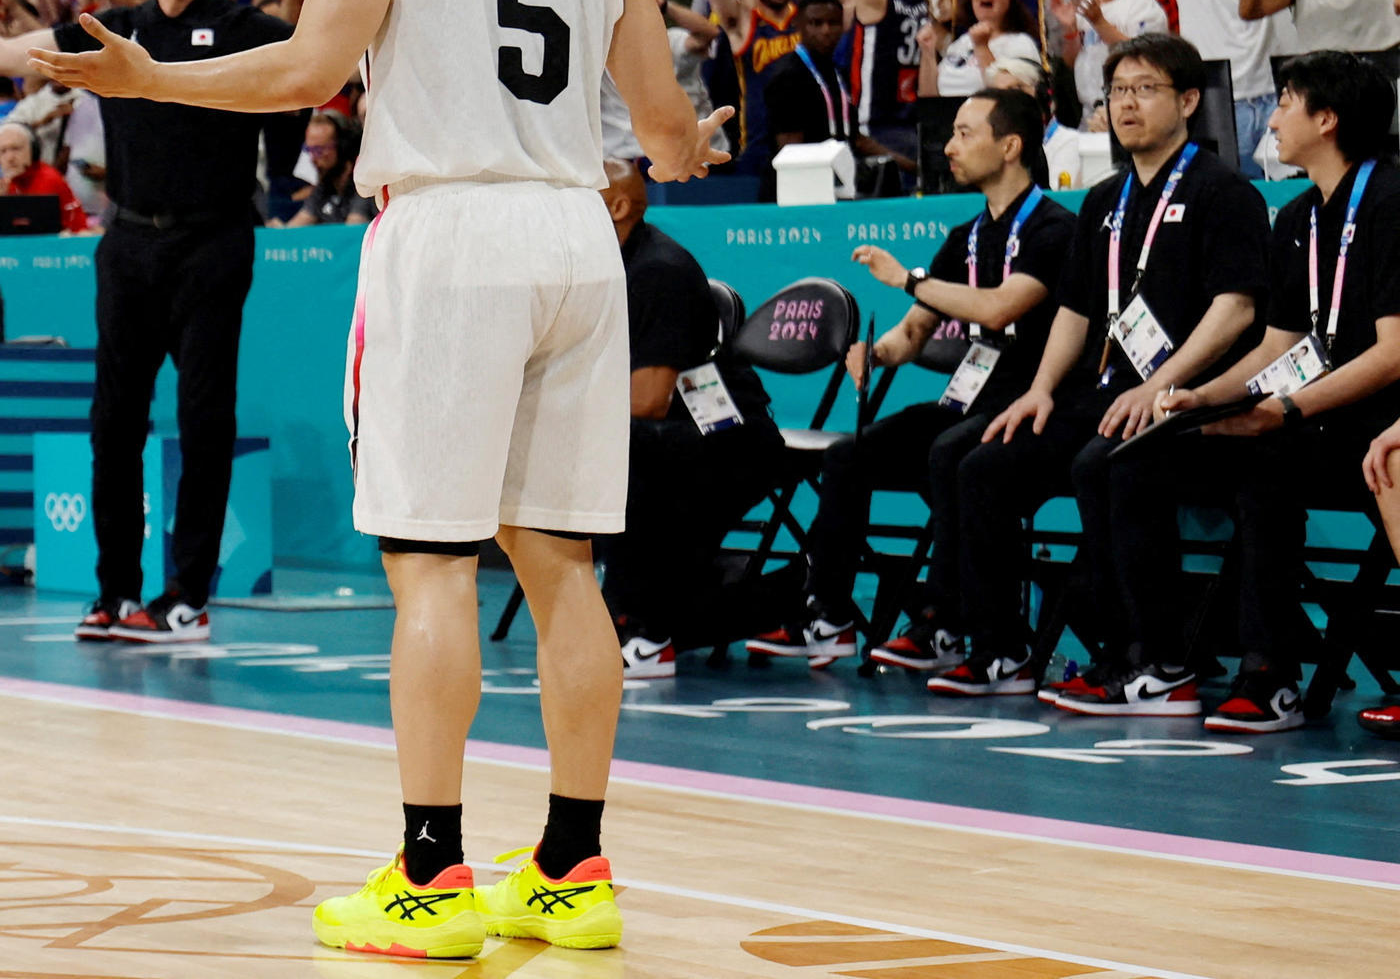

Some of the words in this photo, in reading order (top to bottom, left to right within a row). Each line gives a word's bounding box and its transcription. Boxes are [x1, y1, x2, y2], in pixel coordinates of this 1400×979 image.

[726, 228, 772, 246] PARIS
[778, 226, 822, 244] 2024
[847, 223, 896, 241] PARIS
[902, 221, 949, 240] 2024
[772, 299, 824, 320] PARIS
[767, 320, 819, 341] 2024
